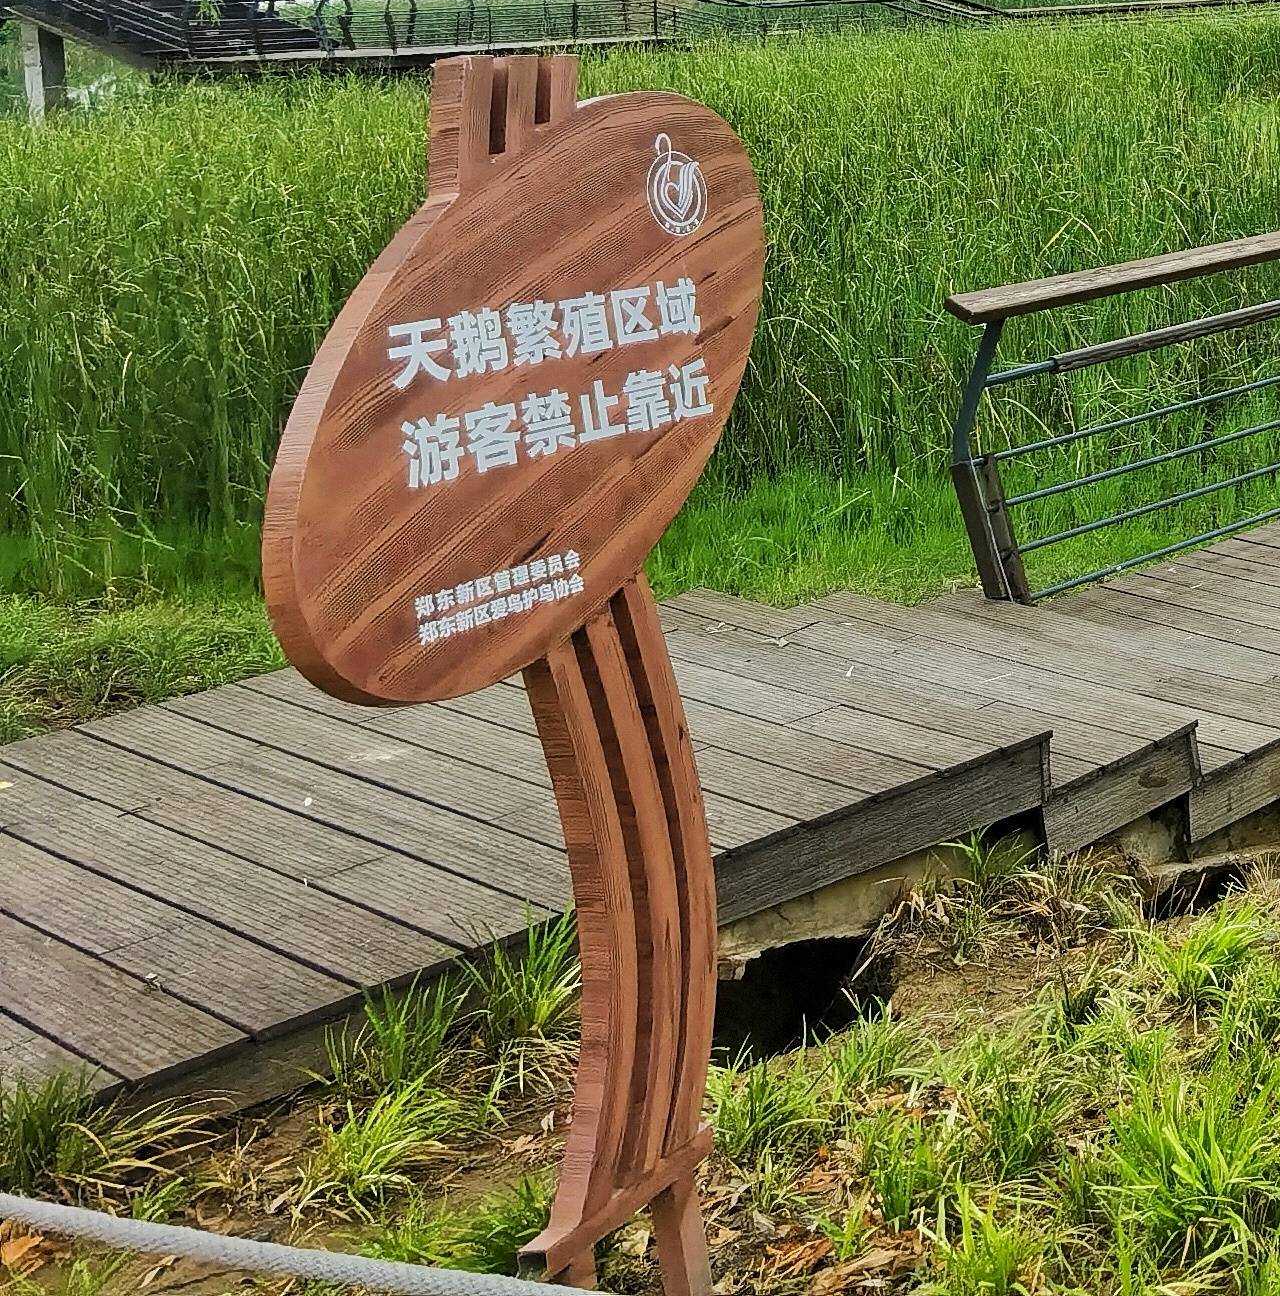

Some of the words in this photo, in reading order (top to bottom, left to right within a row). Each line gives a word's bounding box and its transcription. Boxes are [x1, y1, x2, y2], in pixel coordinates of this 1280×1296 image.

[388, 277, 701, 389] 天鹅繁殖区域
[400, 359, 714, 489] 游客禁止靠近
[415, 549, 581, 618] 郑东新区管理委员会
